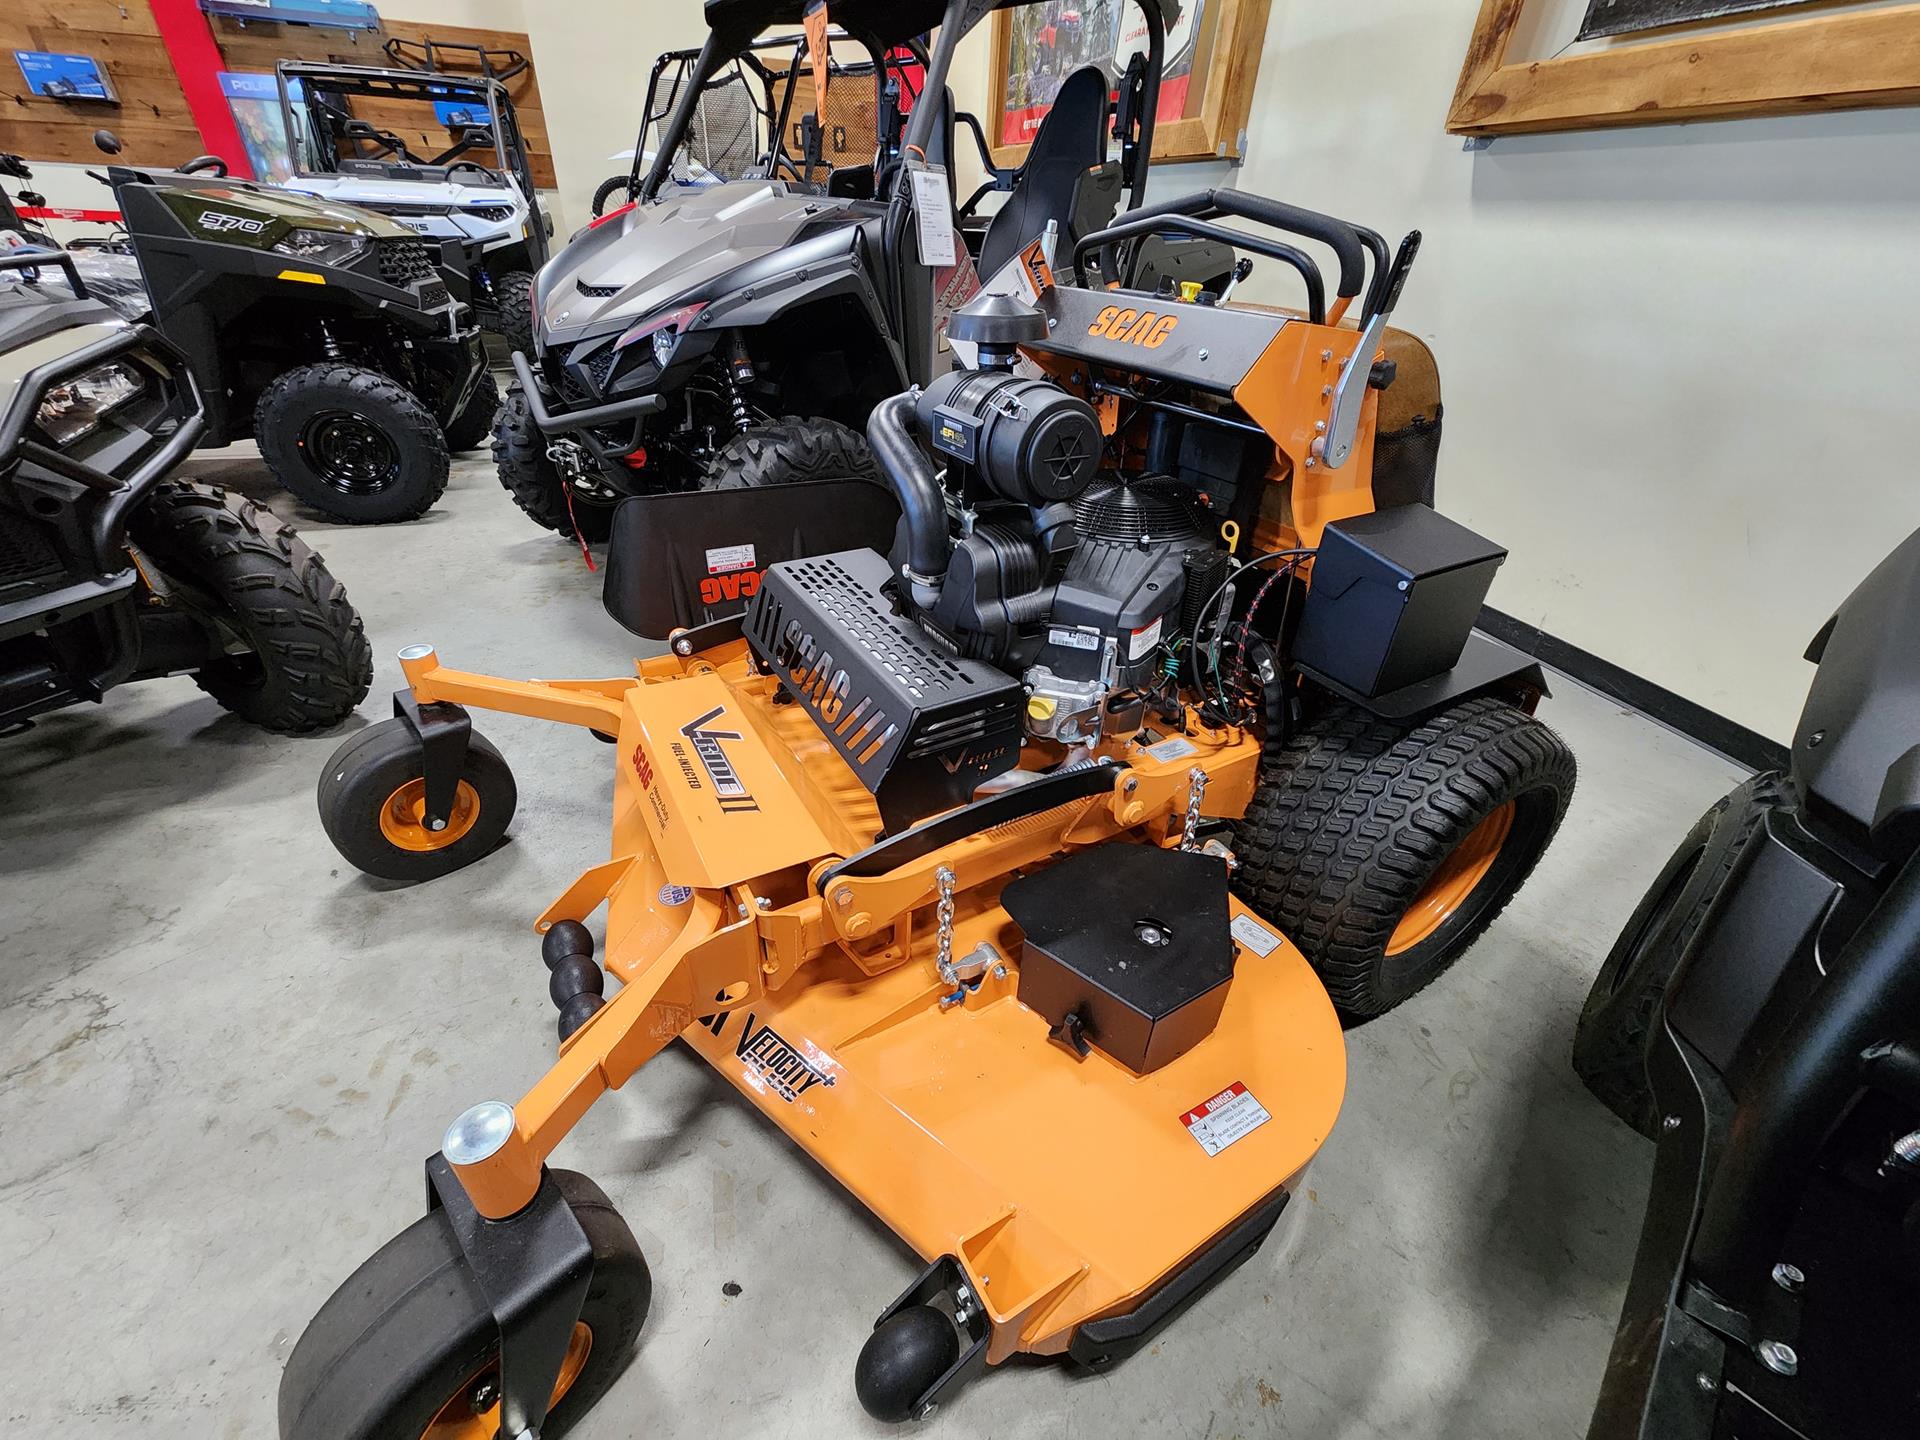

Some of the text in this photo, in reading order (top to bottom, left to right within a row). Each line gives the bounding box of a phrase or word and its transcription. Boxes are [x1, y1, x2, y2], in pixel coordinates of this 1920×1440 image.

[199, 211, 264, 234] 570
[1088, 305, 1179, 349] SCAG
[774, 618, 851, 724] SCAG
[632, 743, 654, 791] SCAG
[670, 742, 702, 790] FUEL-INJECTED
[648, 792, 667, 831] Commercial
[653, 784, 669, 822] Heavy-Duty
[671, 888, 685, 904] USA
[1205, 1089, 1236, 1112] DANGER
[1210, 1096, 1250, 1122] SPINNING BLADES
